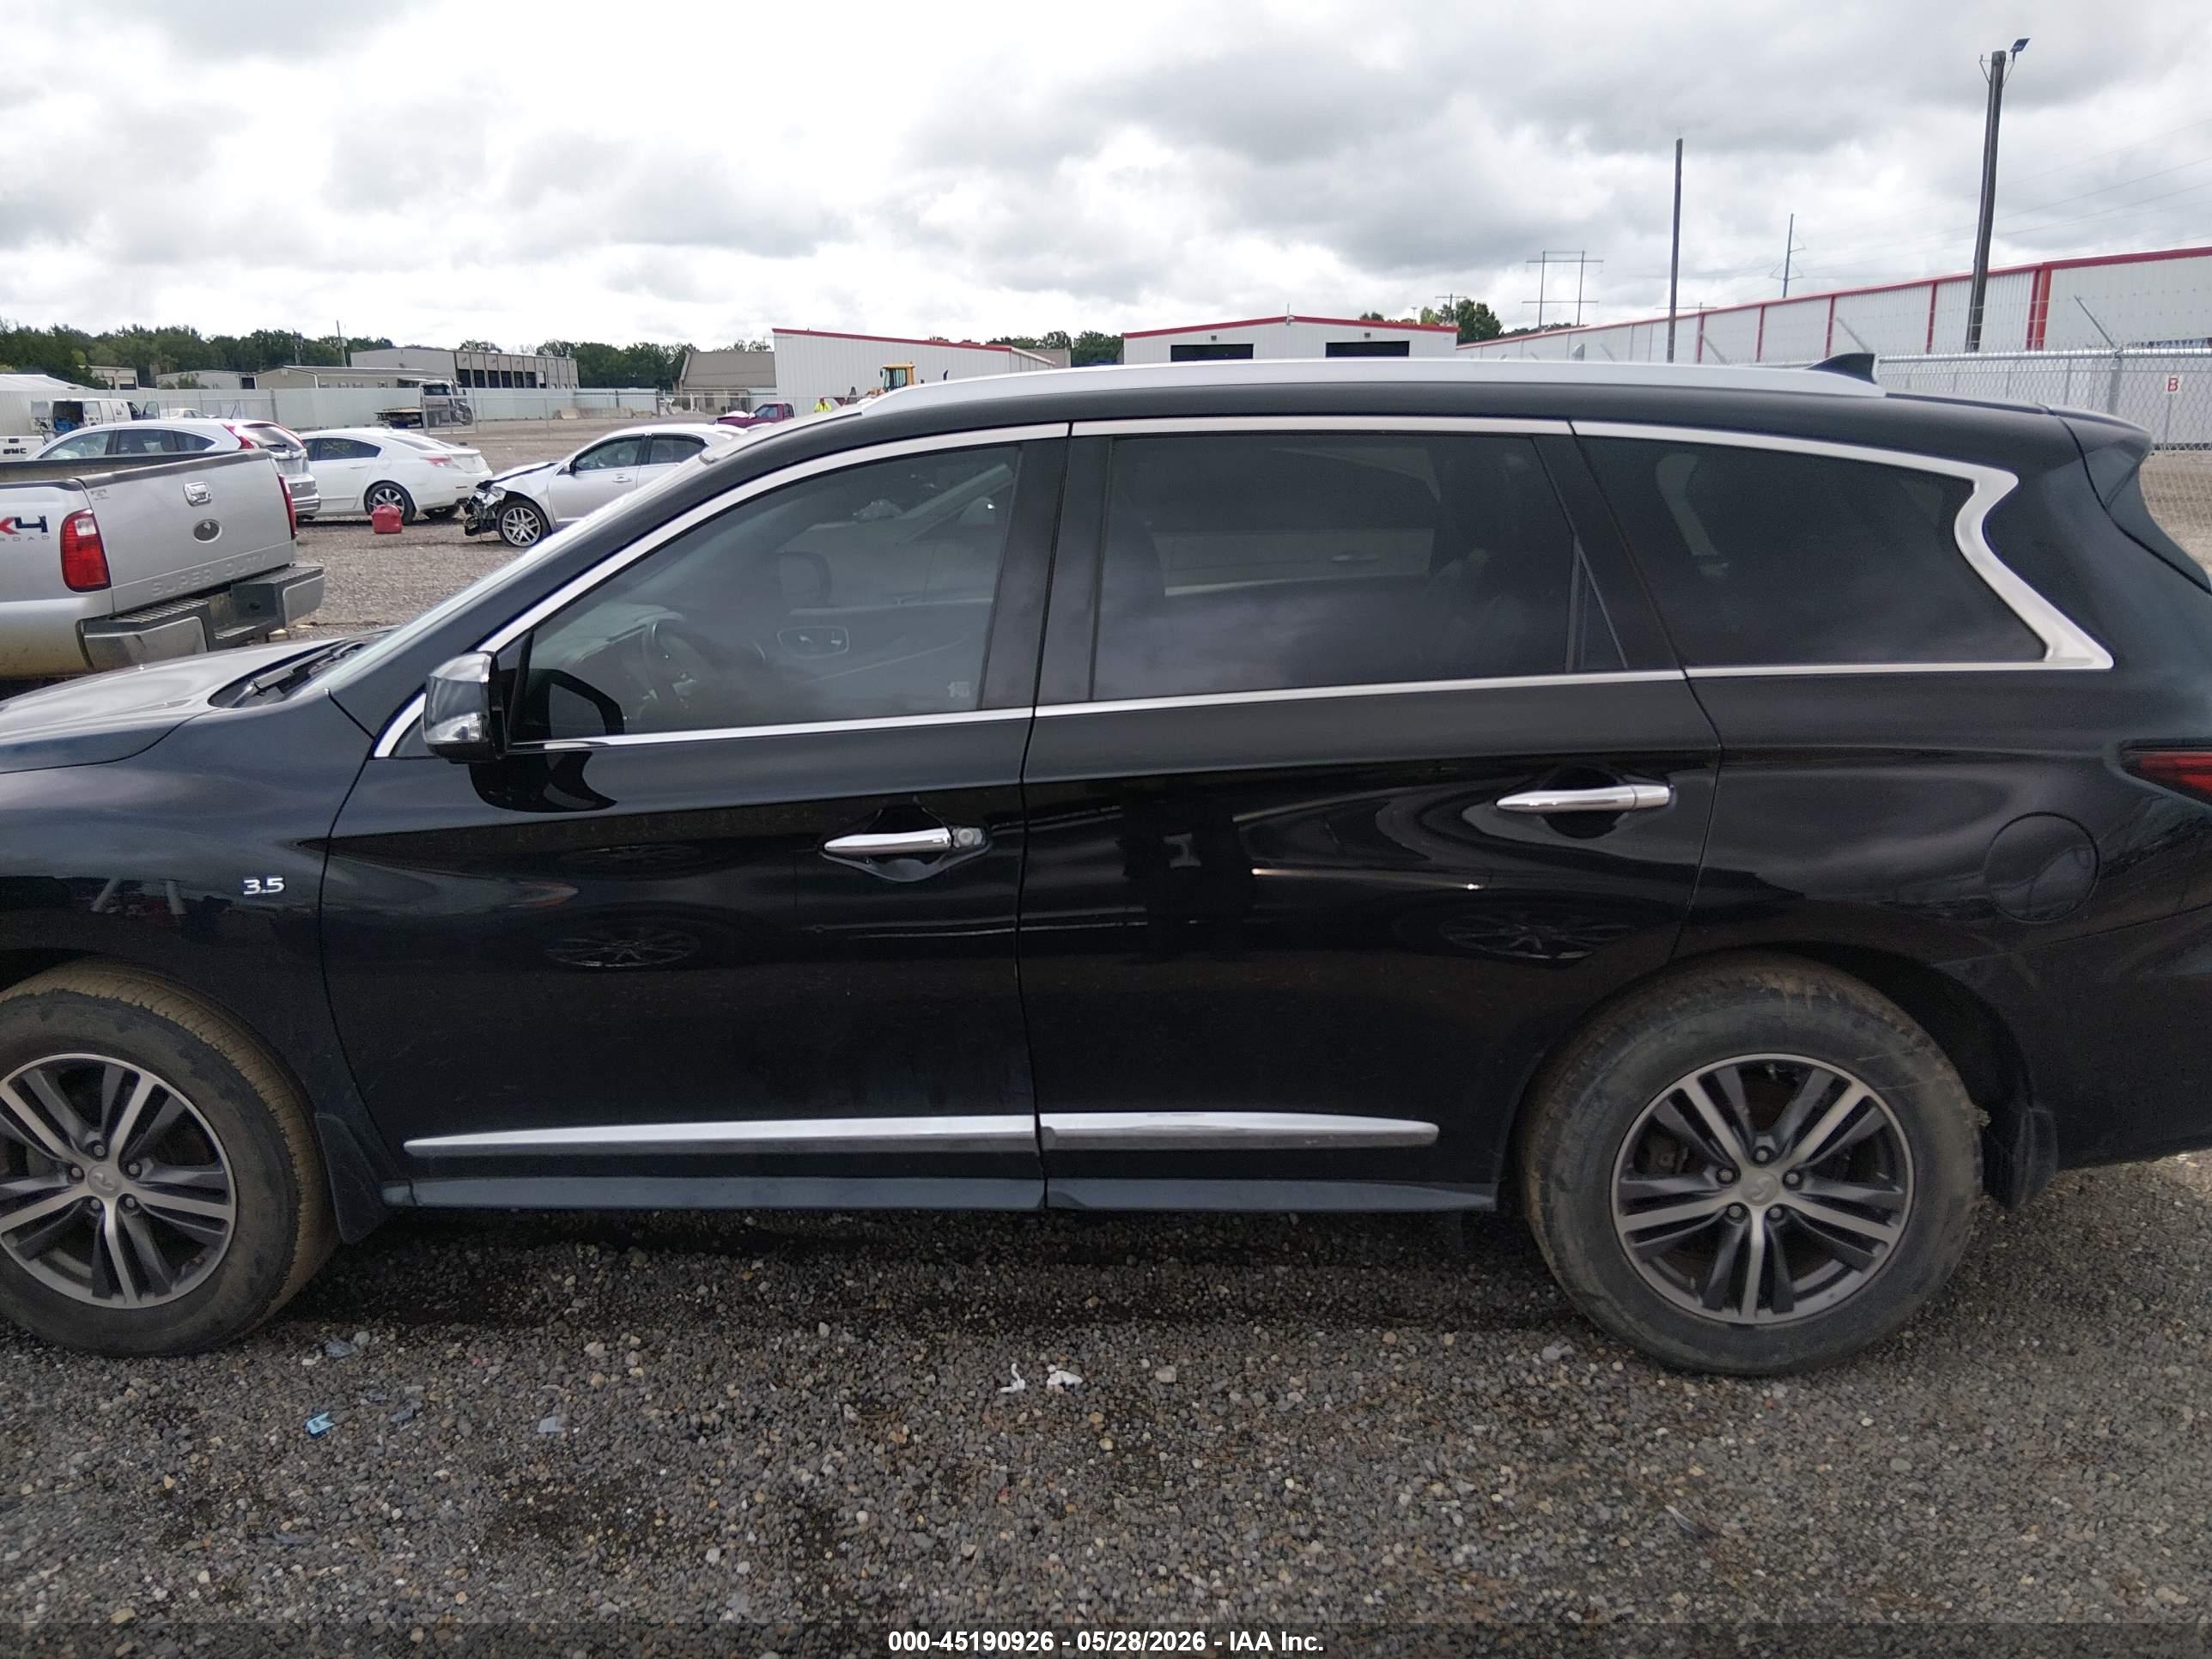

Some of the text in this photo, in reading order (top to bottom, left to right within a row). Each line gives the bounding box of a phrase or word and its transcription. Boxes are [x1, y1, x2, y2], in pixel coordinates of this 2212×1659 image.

[2167, 376, 2179, 392] B
[150, 566, 215, 598] SUPER
[243, 877, 285, 895] 3.5
